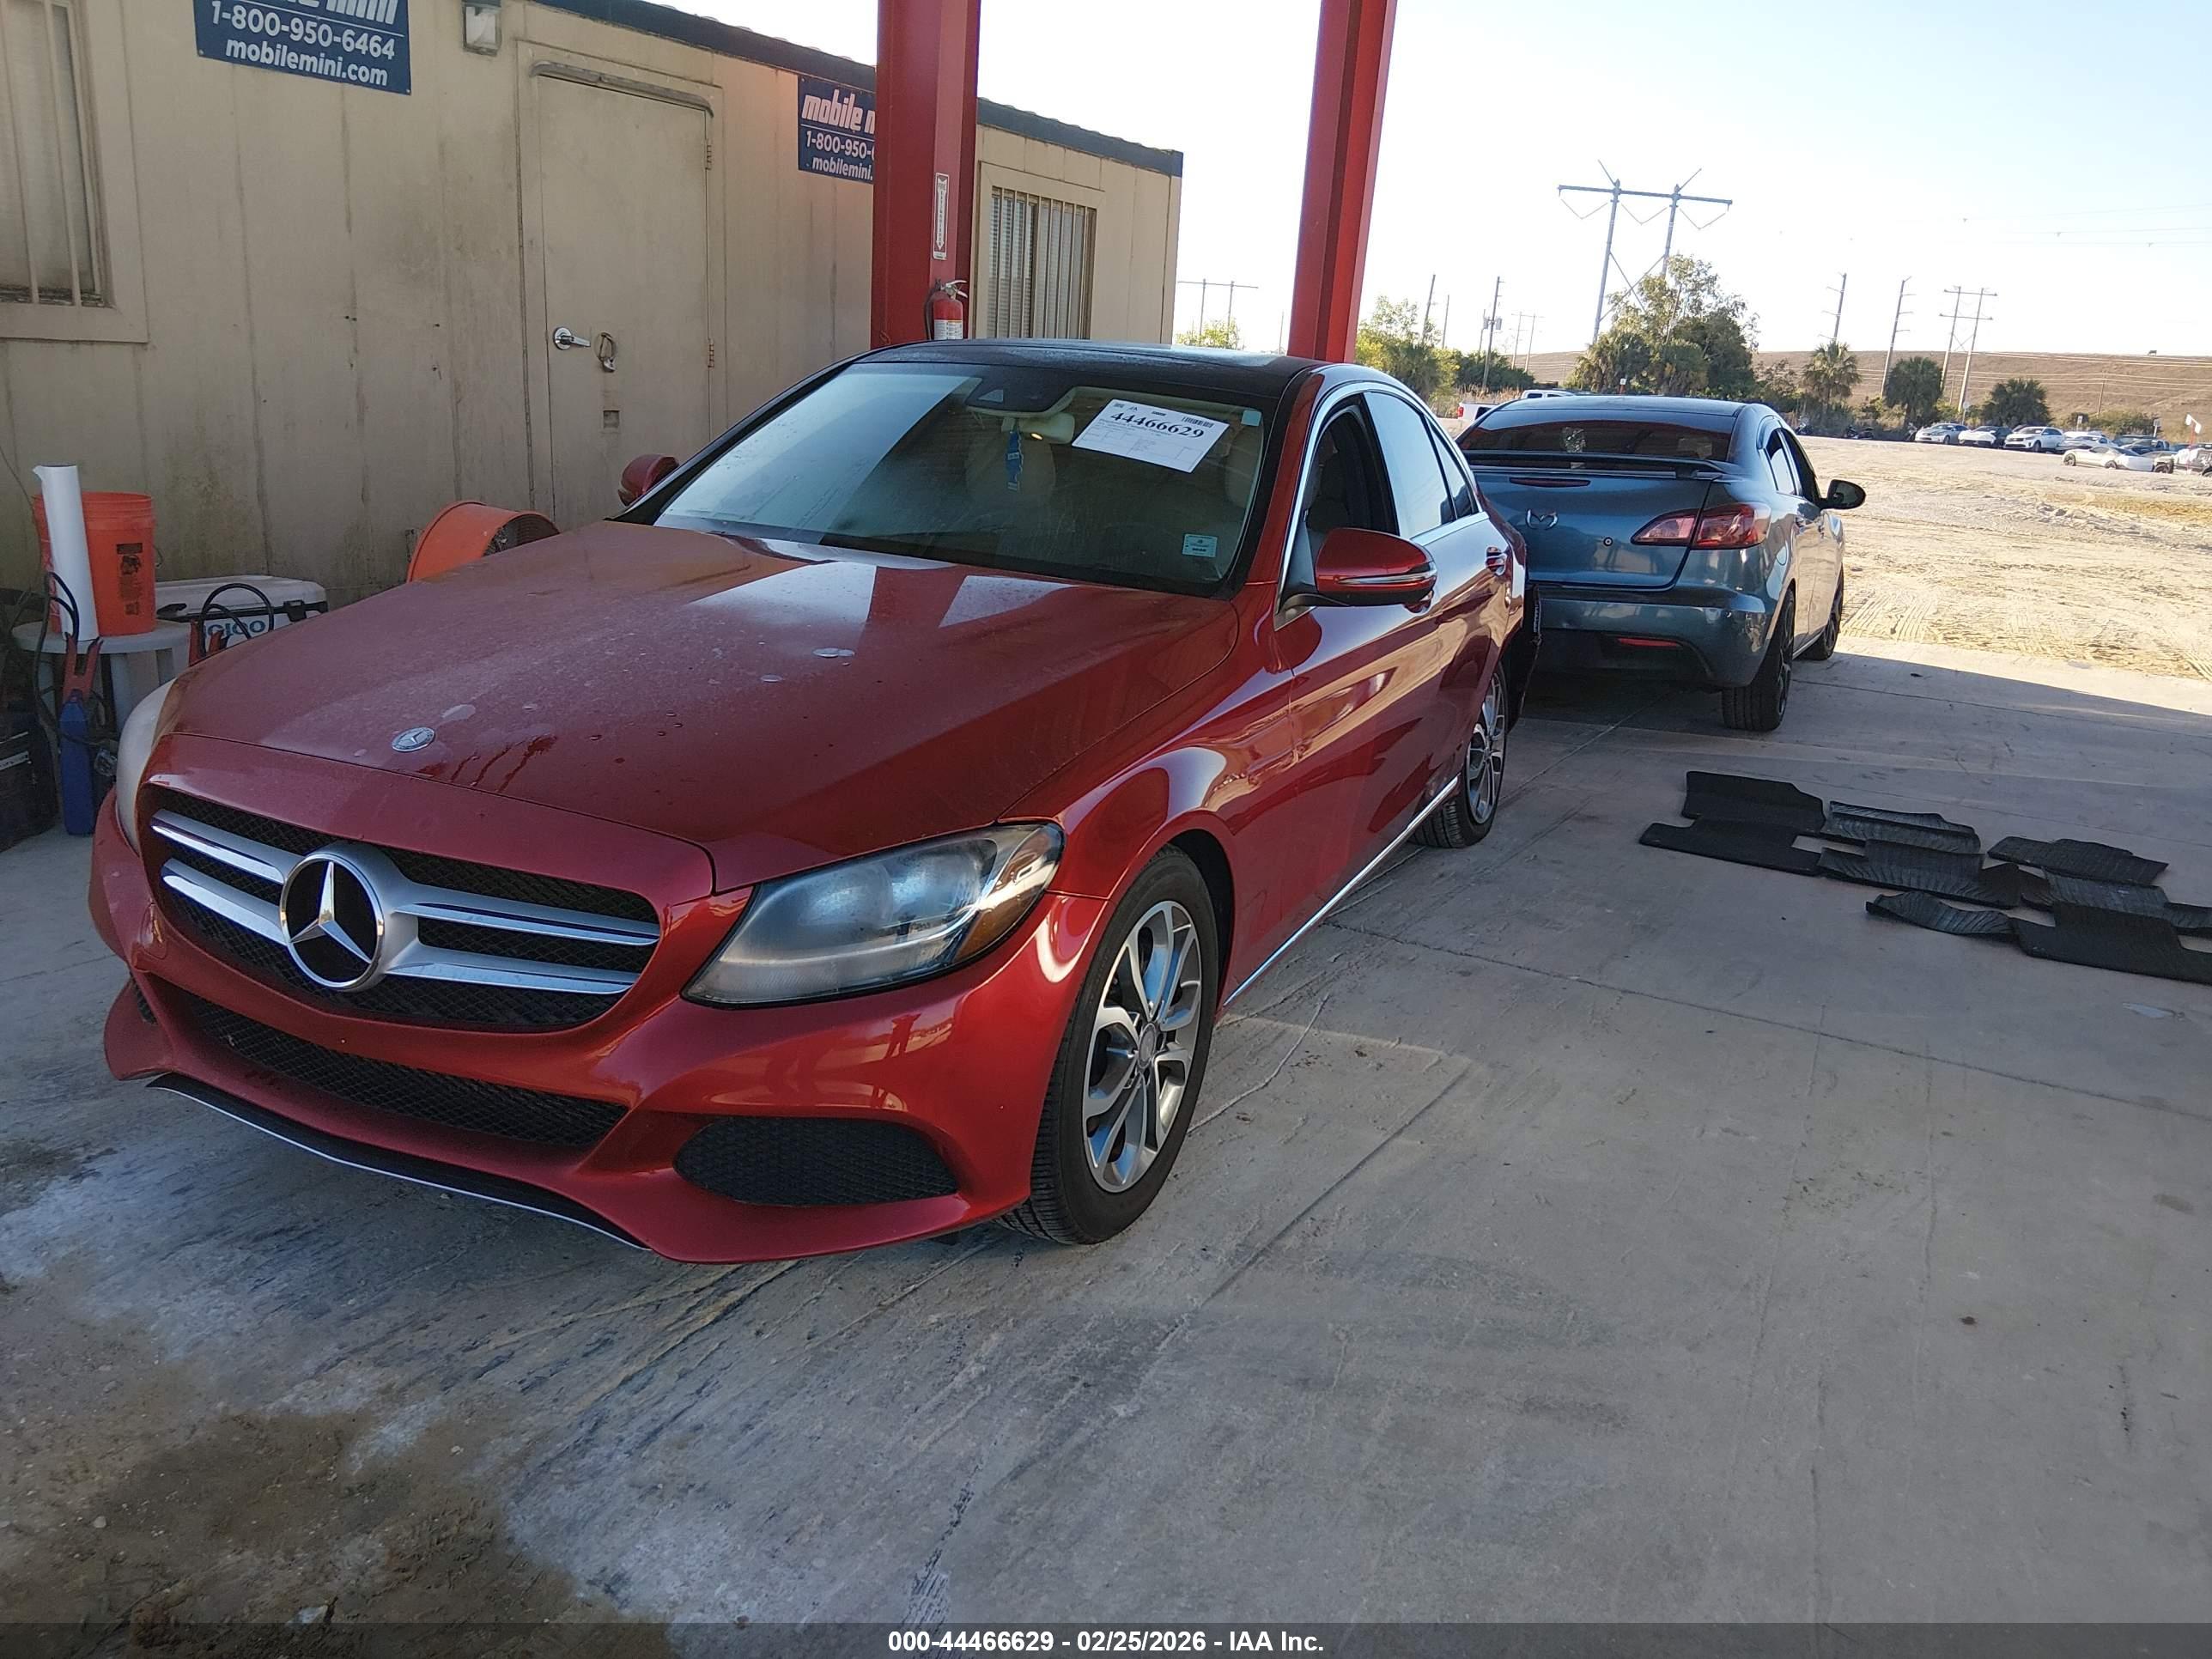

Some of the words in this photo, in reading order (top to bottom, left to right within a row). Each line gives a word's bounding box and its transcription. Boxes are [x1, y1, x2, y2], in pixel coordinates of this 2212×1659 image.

[211, 1, 396, 60] 1-800-950-6464
[225, 39, 388, 86] mobilemini.com
[801, 88, 864, 131] mobile
[806, 131, 875, 161] 1-800-950-
[1109, 411, 1205, 439] 44466629
